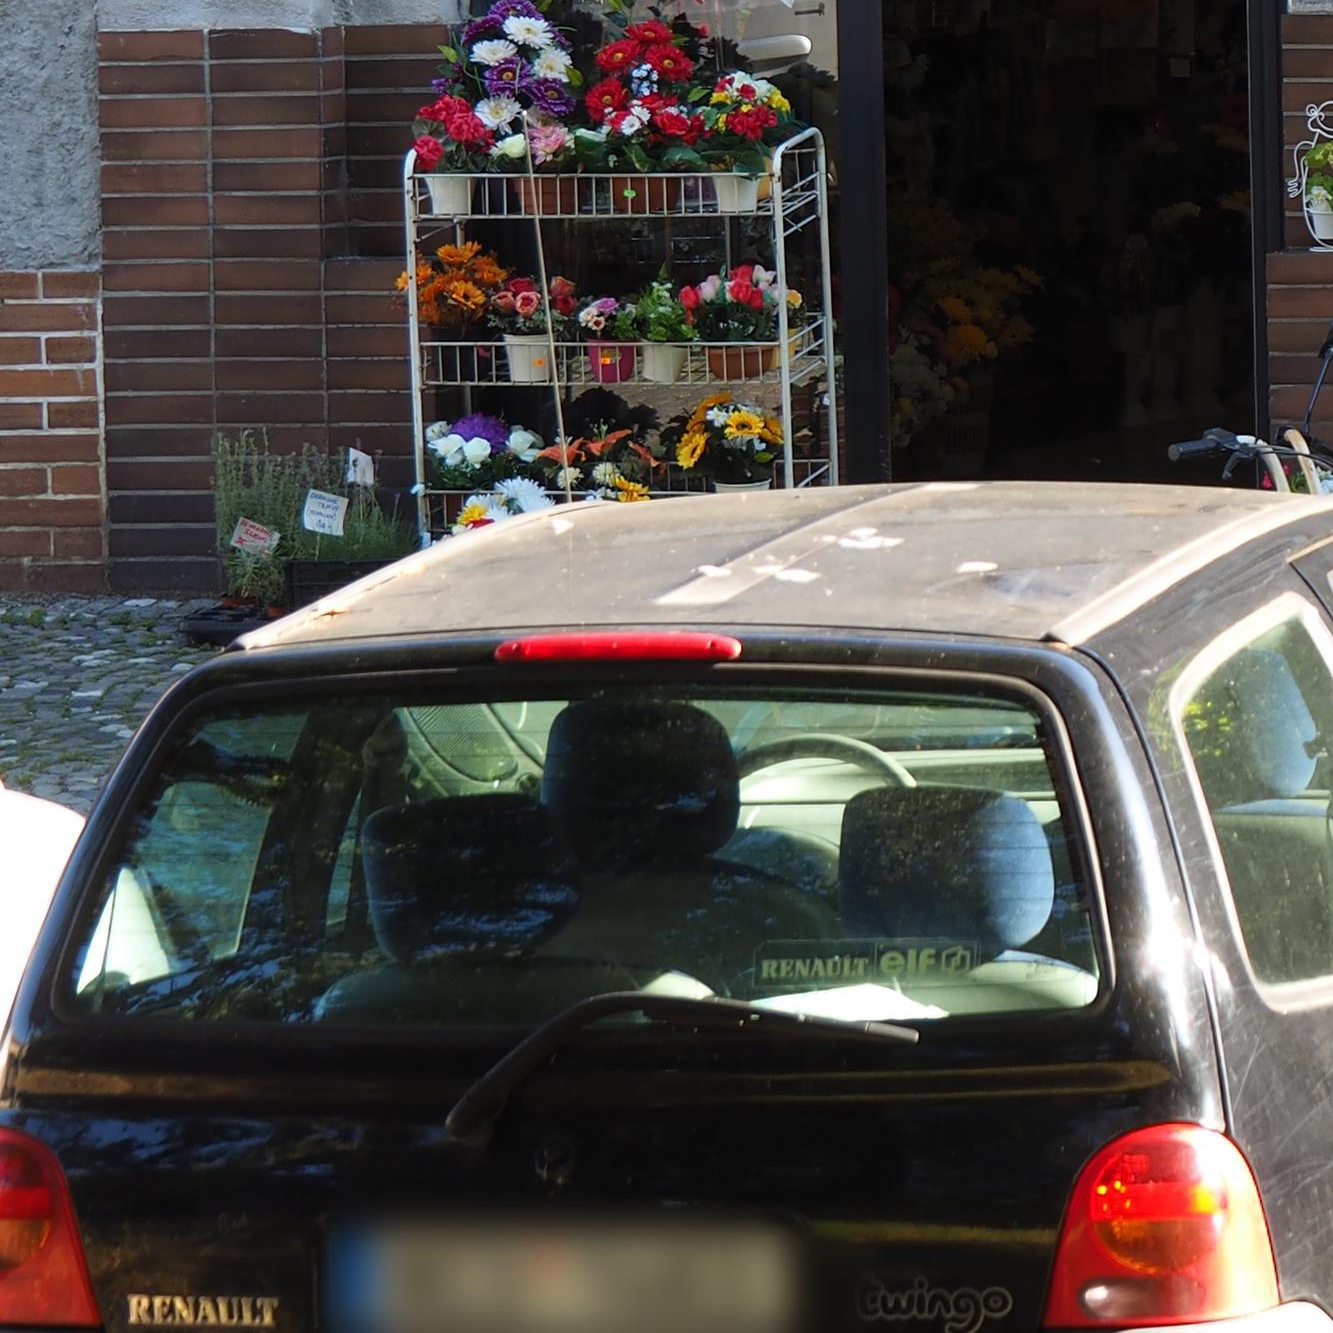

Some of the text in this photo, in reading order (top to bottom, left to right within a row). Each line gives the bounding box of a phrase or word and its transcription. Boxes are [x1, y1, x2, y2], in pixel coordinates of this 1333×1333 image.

[760, 947, 936, 978] RENAULT elf
[127, 1293, 279, 1326] RENAULT
[857, 1276, 1013, 1333] twingo
